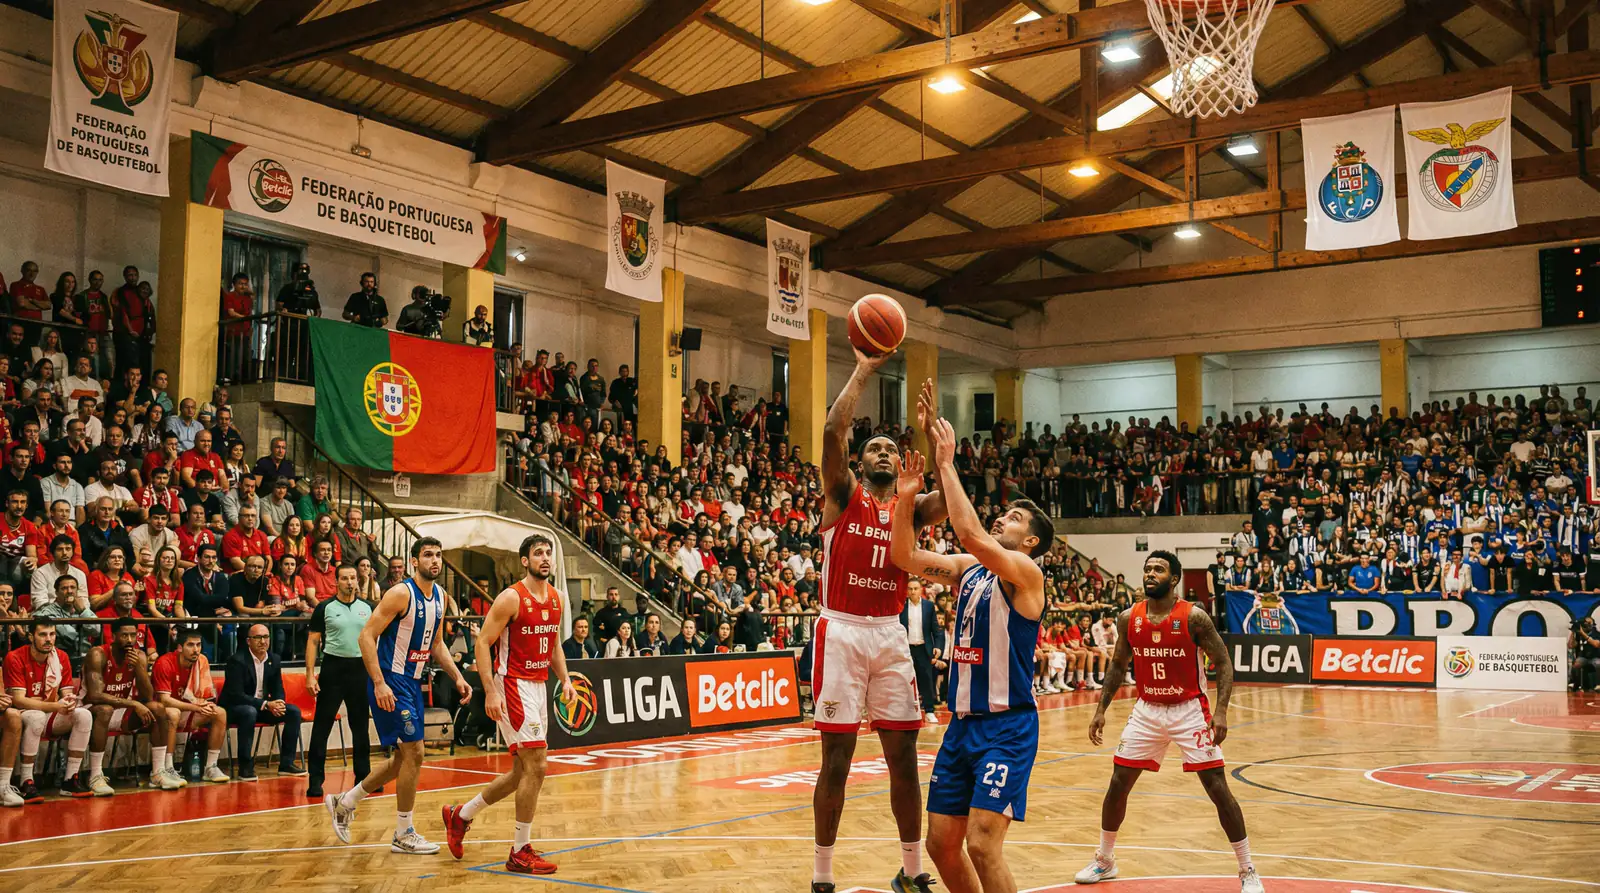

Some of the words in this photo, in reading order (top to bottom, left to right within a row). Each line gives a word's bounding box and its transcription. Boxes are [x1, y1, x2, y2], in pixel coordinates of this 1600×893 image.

[76, 112, 146, 140] FEDERAÇÃO
[72, 126, 149, 156] PORTUGUESA
[57, 139, 74, 152] DE
[76, 144, 161, 174] BASQUETEBOL
[301, 176, 384, 210] FEDERAÇÃO
[388, 200, 474, 234] PORTUGUESA
[317, 202, 336, 220] DE
[340, 208, 436, 244] BASQUETEBOL
[847, 522, 862, 536] SL
[864, 526, 892, 542] BEN
[871, 544, 886, 568] 11
[521, 626, 533, 634] SL
[540, 637, 548, 654] 18
[1144, 648, 1186, 658] BENFICA
[1234, 644, 1304, 673] LIGA
[1517, 654, 1559, 662] PORTUGUESA
[1320, 648, 1424, 674] Betclic
[1479, 662, 1490, 671] DE
[1493, 663, 1559, 673] BASQUETEBOL
[602, 676, 682, 724] LIGA
[698, 668, 790, 714] Betclic
[982, 762, 1008, 788] 23
